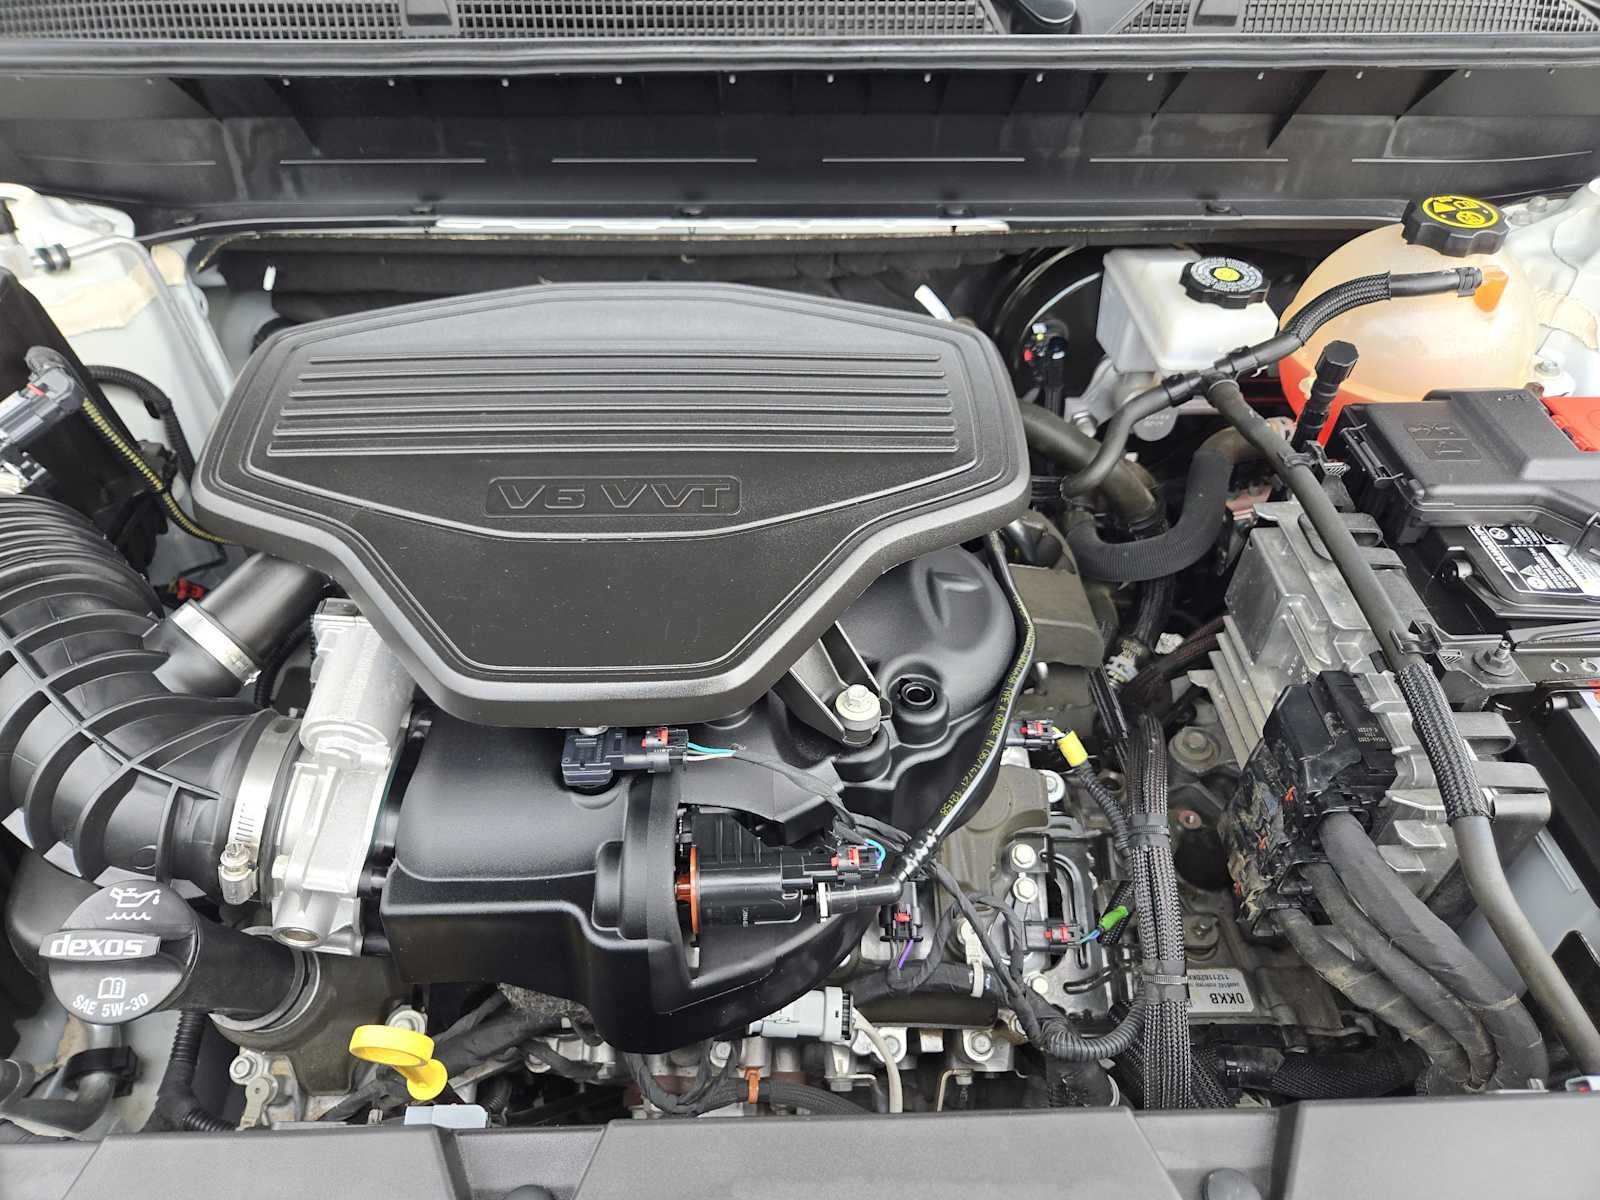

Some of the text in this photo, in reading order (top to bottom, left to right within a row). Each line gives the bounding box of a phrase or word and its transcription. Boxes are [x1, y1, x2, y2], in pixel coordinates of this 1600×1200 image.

[498, 483, 730, 509] V6 VVT
[50, 934, 144, 956] dexos
[72, 993, 149, 1018] SAE 5W-30
